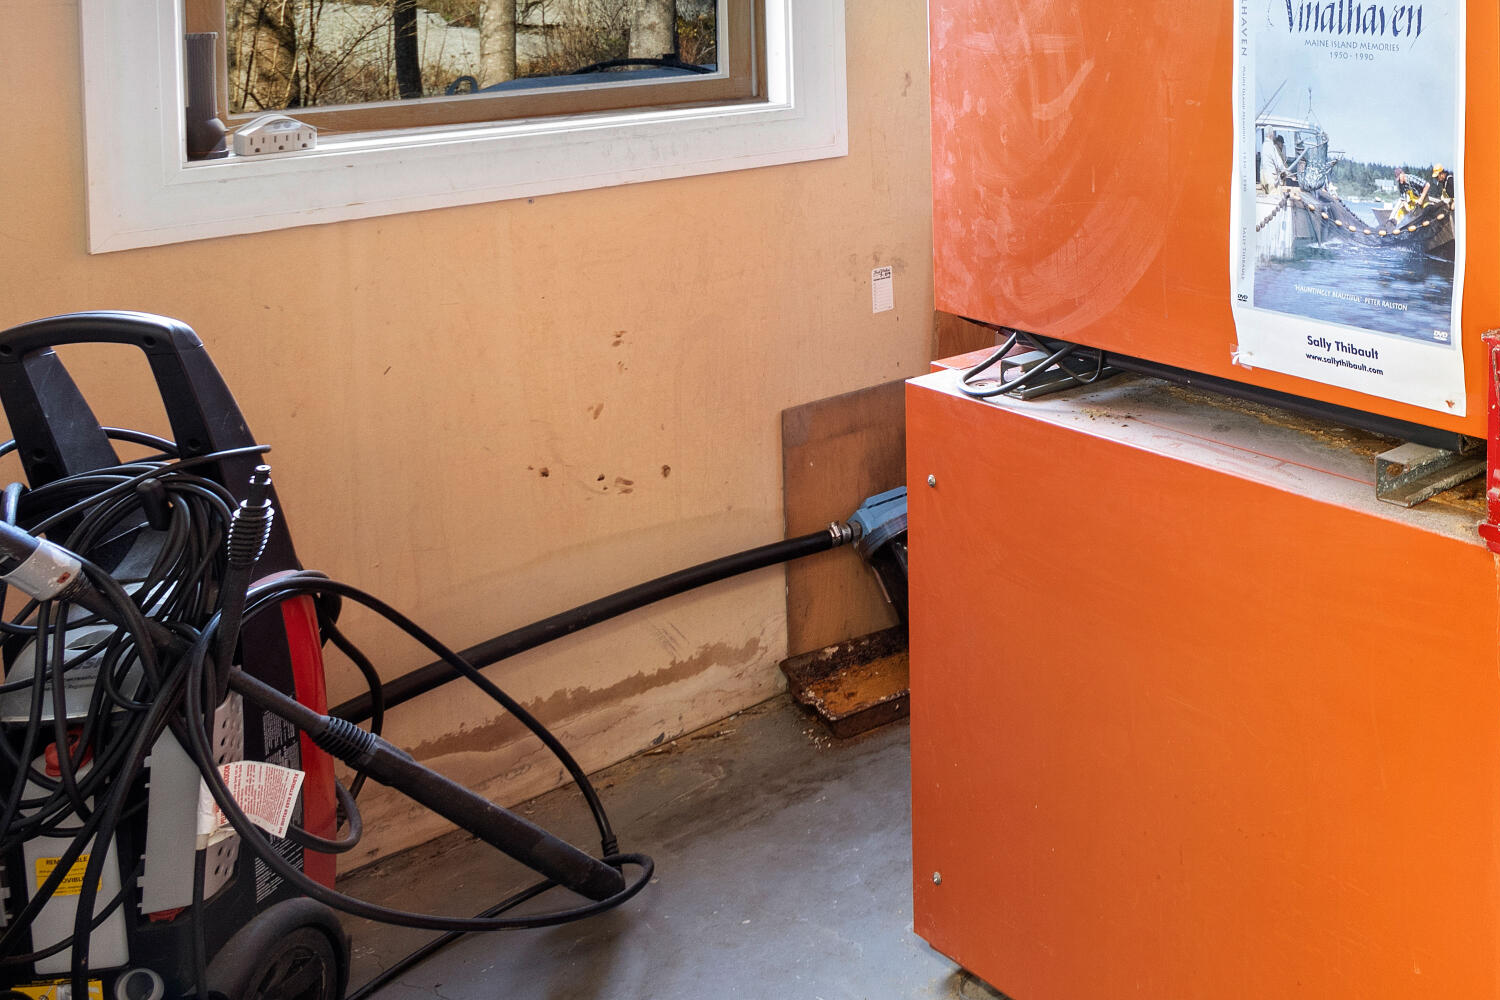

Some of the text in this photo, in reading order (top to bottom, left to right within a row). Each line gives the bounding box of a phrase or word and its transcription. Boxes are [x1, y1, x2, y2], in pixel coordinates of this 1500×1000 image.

[1305, 40, 1400, 52] MAINE ISLAND MEMORIES
[1330, 52, 1348, 60] 1950
[1355, 53, 1374, 61] 1990
[1364, 298, 1381, 307] PETER
[1382, 301, 1409, 312] RALSTON
[1307, 335, 1379, 360] Sally Thibault
[1305, 352, 1384, 376] www.sallythibault.com
